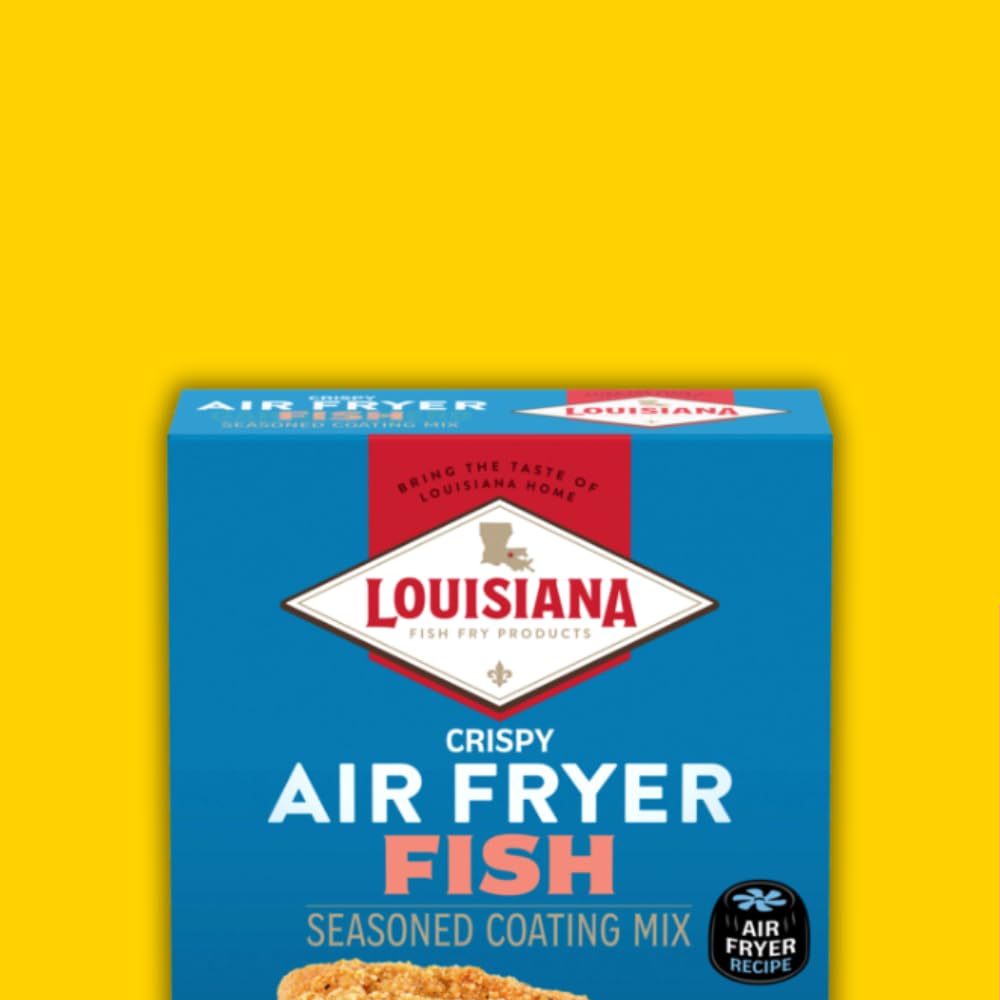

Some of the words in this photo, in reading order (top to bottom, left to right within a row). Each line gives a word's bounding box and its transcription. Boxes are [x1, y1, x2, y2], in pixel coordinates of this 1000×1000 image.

[197, 400, 294, 410] AIR
[313, 400, 487, 410] FRYER
[566, 407, 739, 416] LOUISIANA
[222, 421, 325, 429] SEASONED
[337, 421, 417, 429] COATING
[423, 421, 460, 429] MIX
[279, 411, 404, 420] FISH
[397, 466, 457, 494] BRING
[465, 461, 500, 473] THE
[510, 461, 566, 481] TASTE
[574, 476, 600, 493] OF
[419, 479, 517, 503] LOUISIANA
[526, 481, 576, 503] HOME
[366, 578, 637, 628] LOUISIANA
[409, 628, 448, 639] FISH
[458, 628, 488, 639] FRY
[498, 628, 591, 639] PRODUCTS
[446, 728, 554, 752] CRISPY
[268, 763, 422, 823] AIR
[455, 763, 732, 823] FRYER
[384, 834, 614, 896] FISH
[307, 913, 473, 947] SEASONED
[487, 913, 620, 947] COATING
[634, 913, 690, 946] MIX
[741, 919, 780, 938] AIR
[725, 938, 797, 957] FRYER
[729, 957, 793, 975] RECIPE
